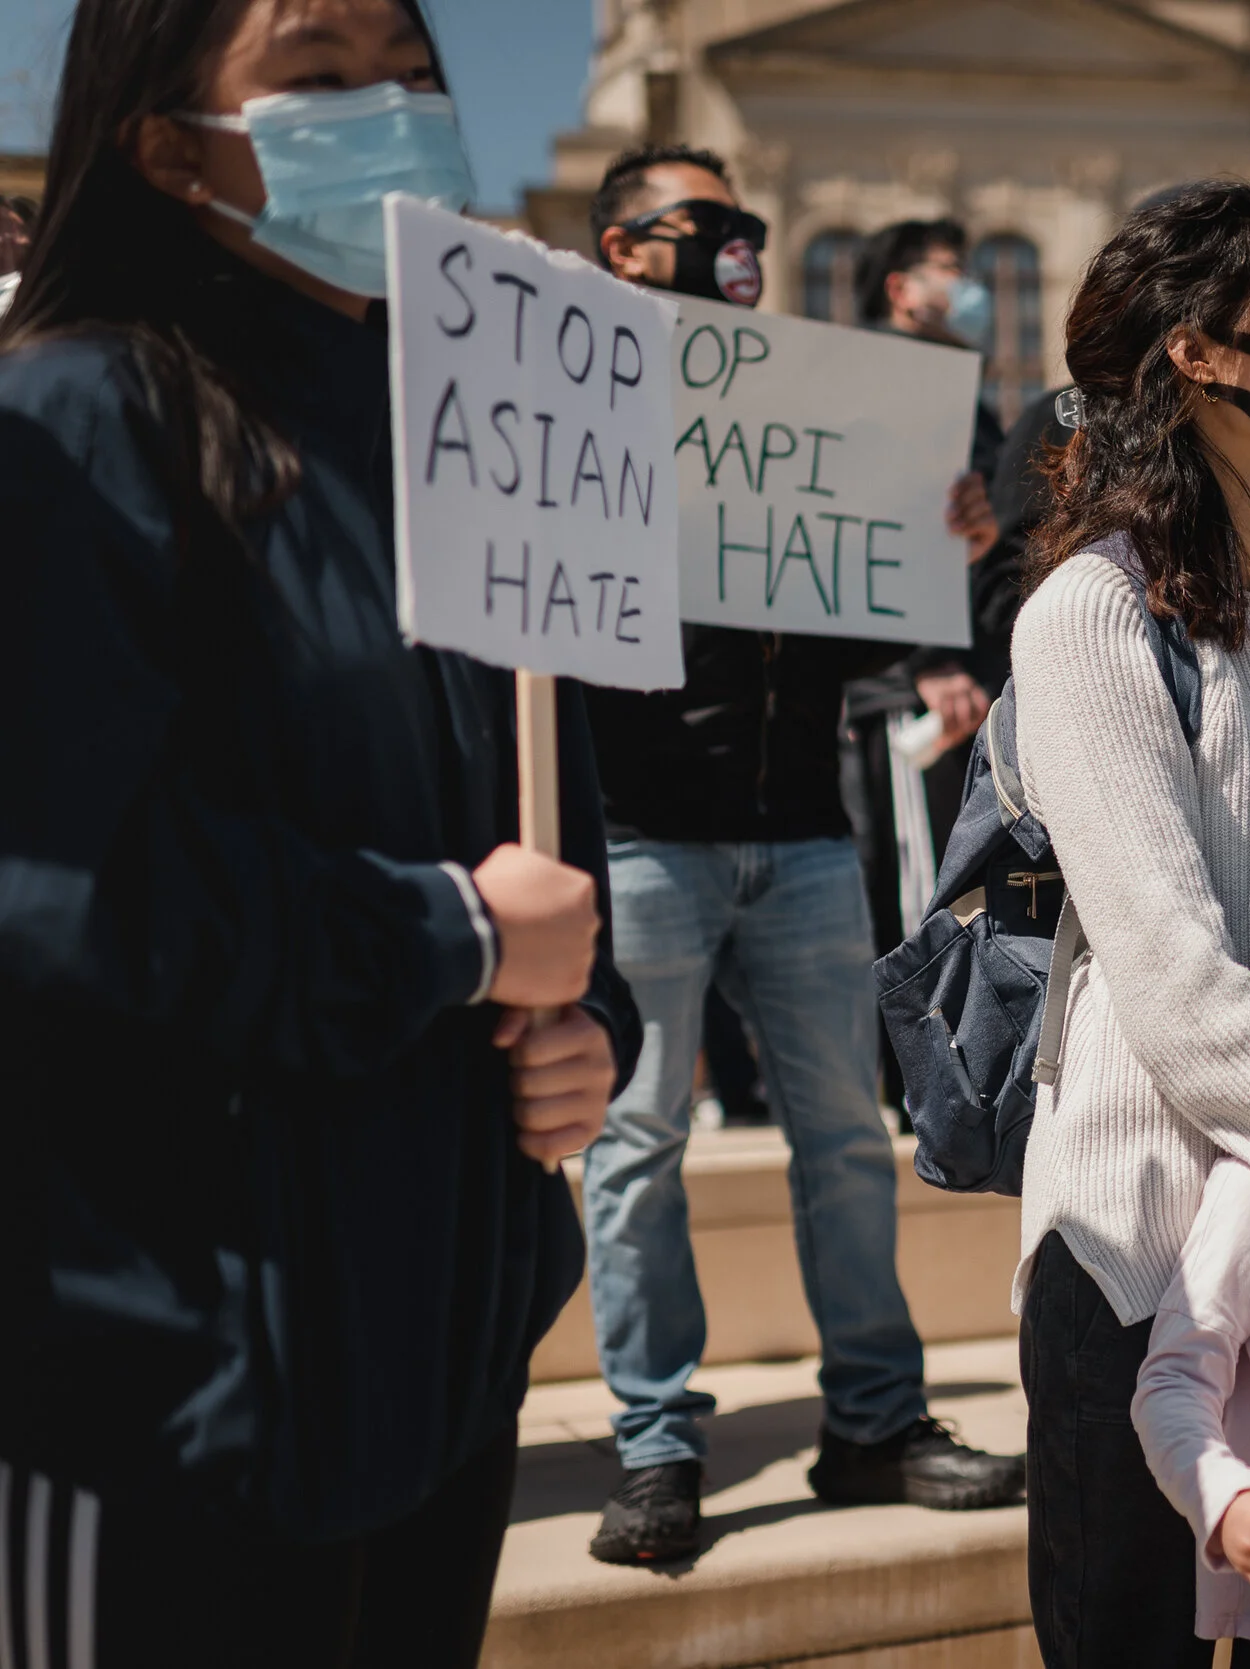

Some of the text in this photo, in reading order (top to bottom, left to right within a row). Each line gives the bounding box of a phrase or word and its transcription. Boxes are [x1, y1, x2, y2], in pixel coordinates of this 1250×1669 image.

[437, 244, 643, 409] STOP
[677, 317, 771, 399] OP
[426, 378, 654, 526] ASIAN
[675, 415, 845, 497] AAPI
[485, 540, 641, 643] HATE
[717, 502, 906, 618] HATE
